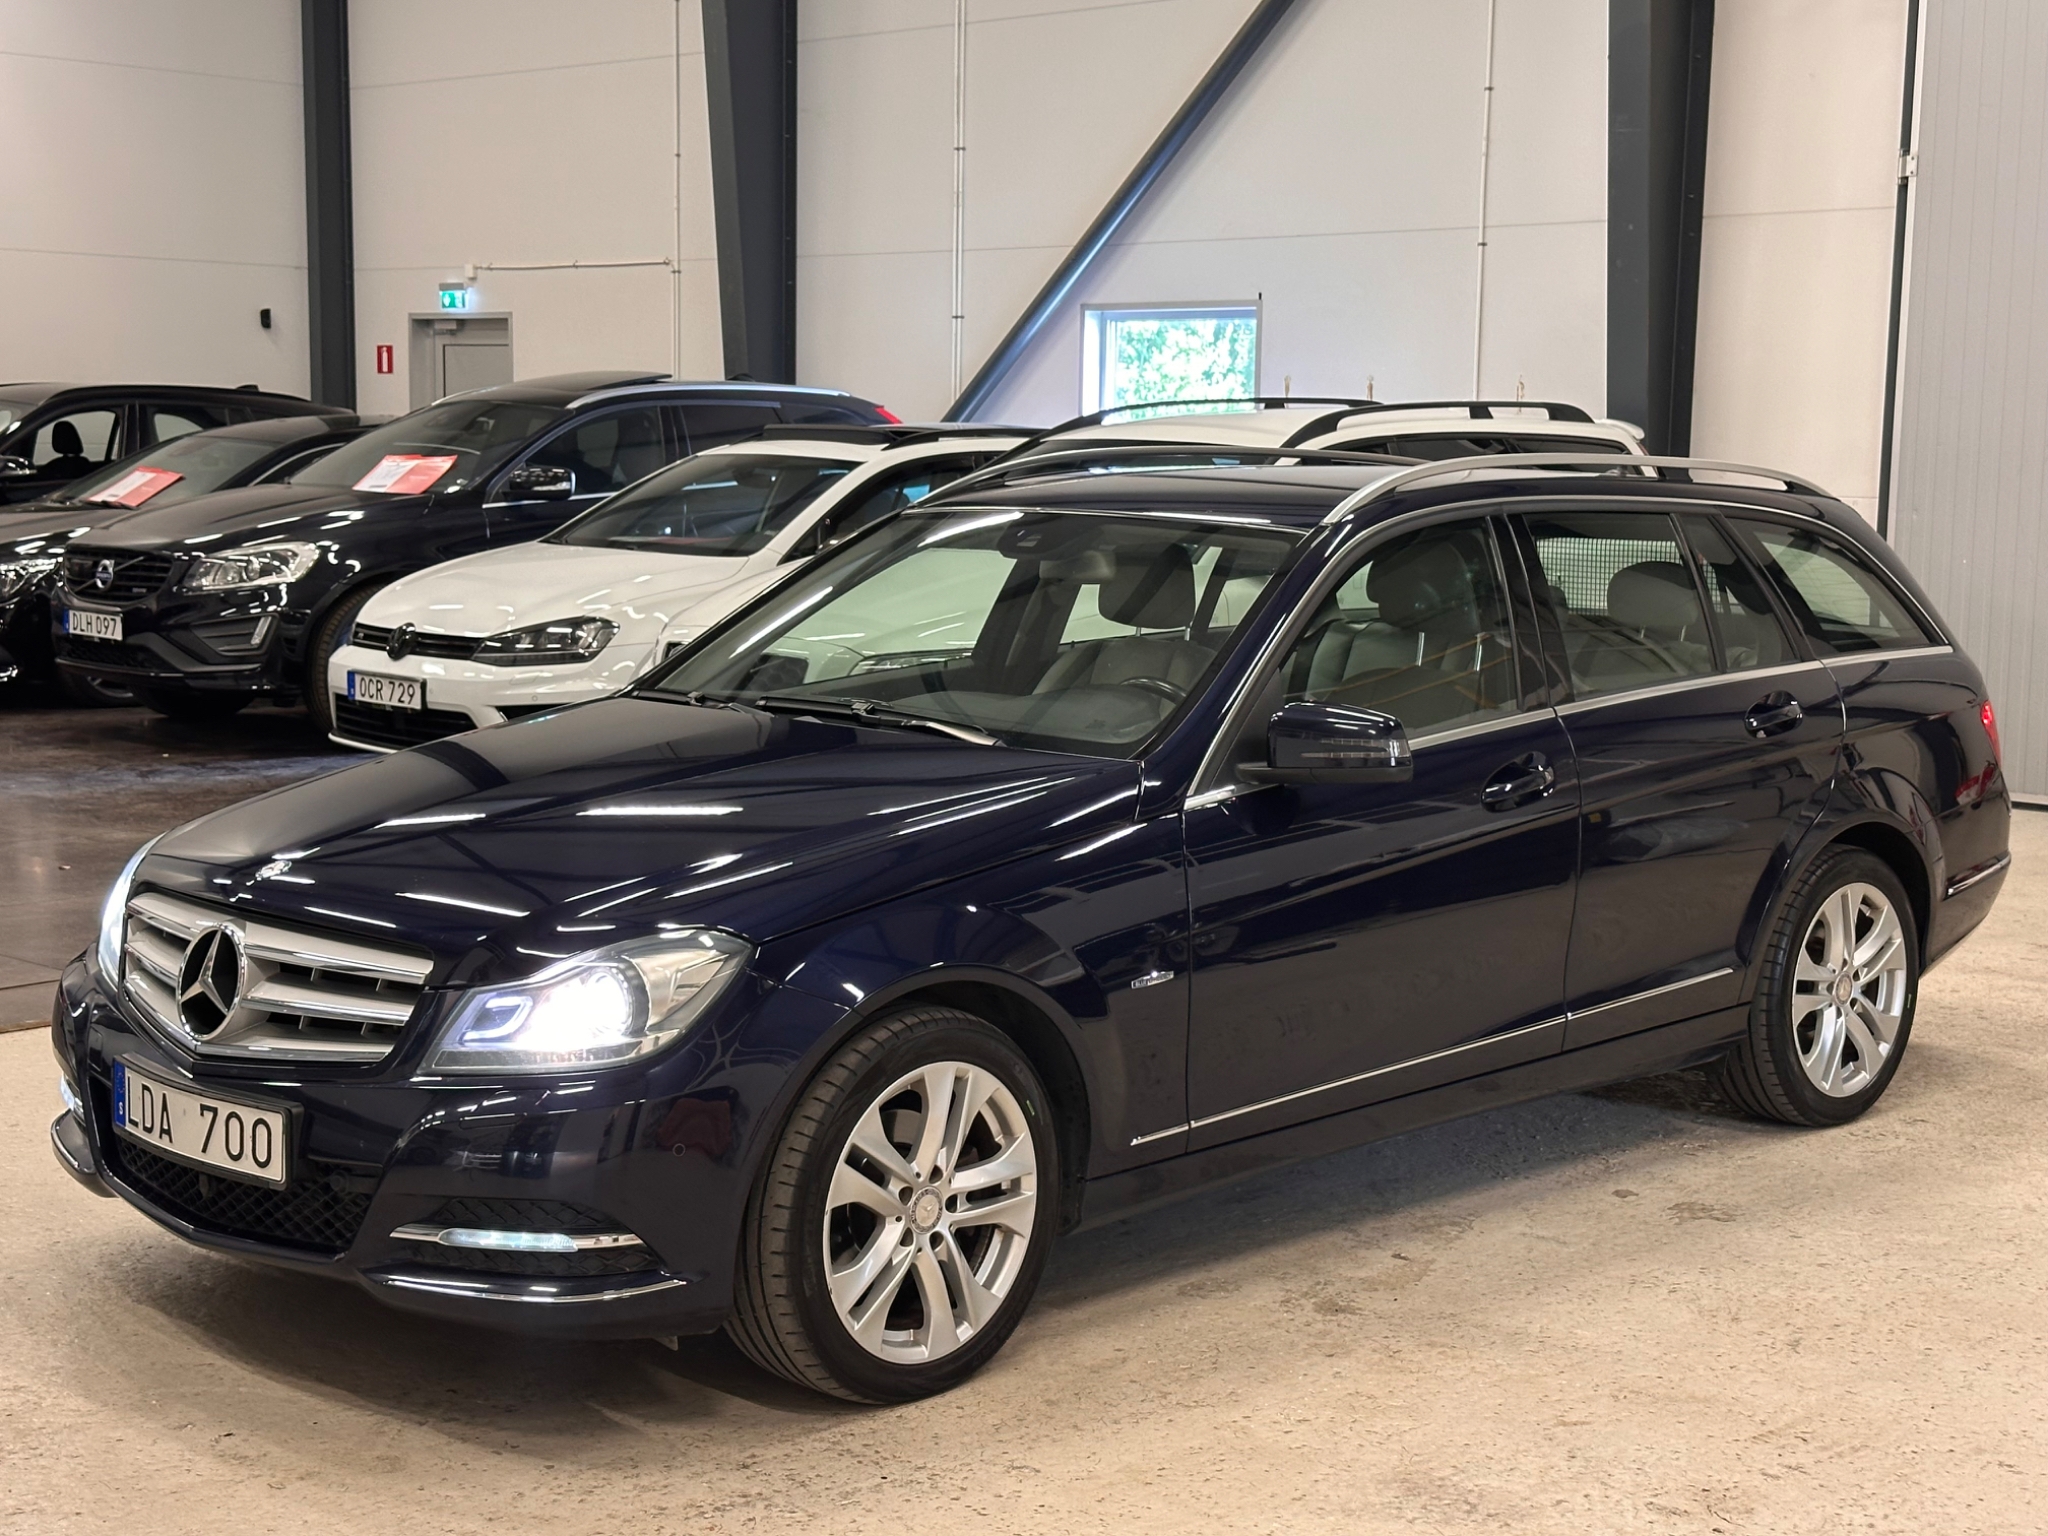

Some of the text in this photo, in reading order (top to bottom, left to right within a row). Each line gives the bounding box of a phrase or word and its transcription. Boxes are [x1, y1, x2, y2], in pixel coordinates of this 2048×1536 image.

[73, 612, 117, 637] DLH 097
[360, 676, 415, 705] OCR 729
[127, 1075, 173, 1144] LDA
[200, 1102, 272, 1169] 700
